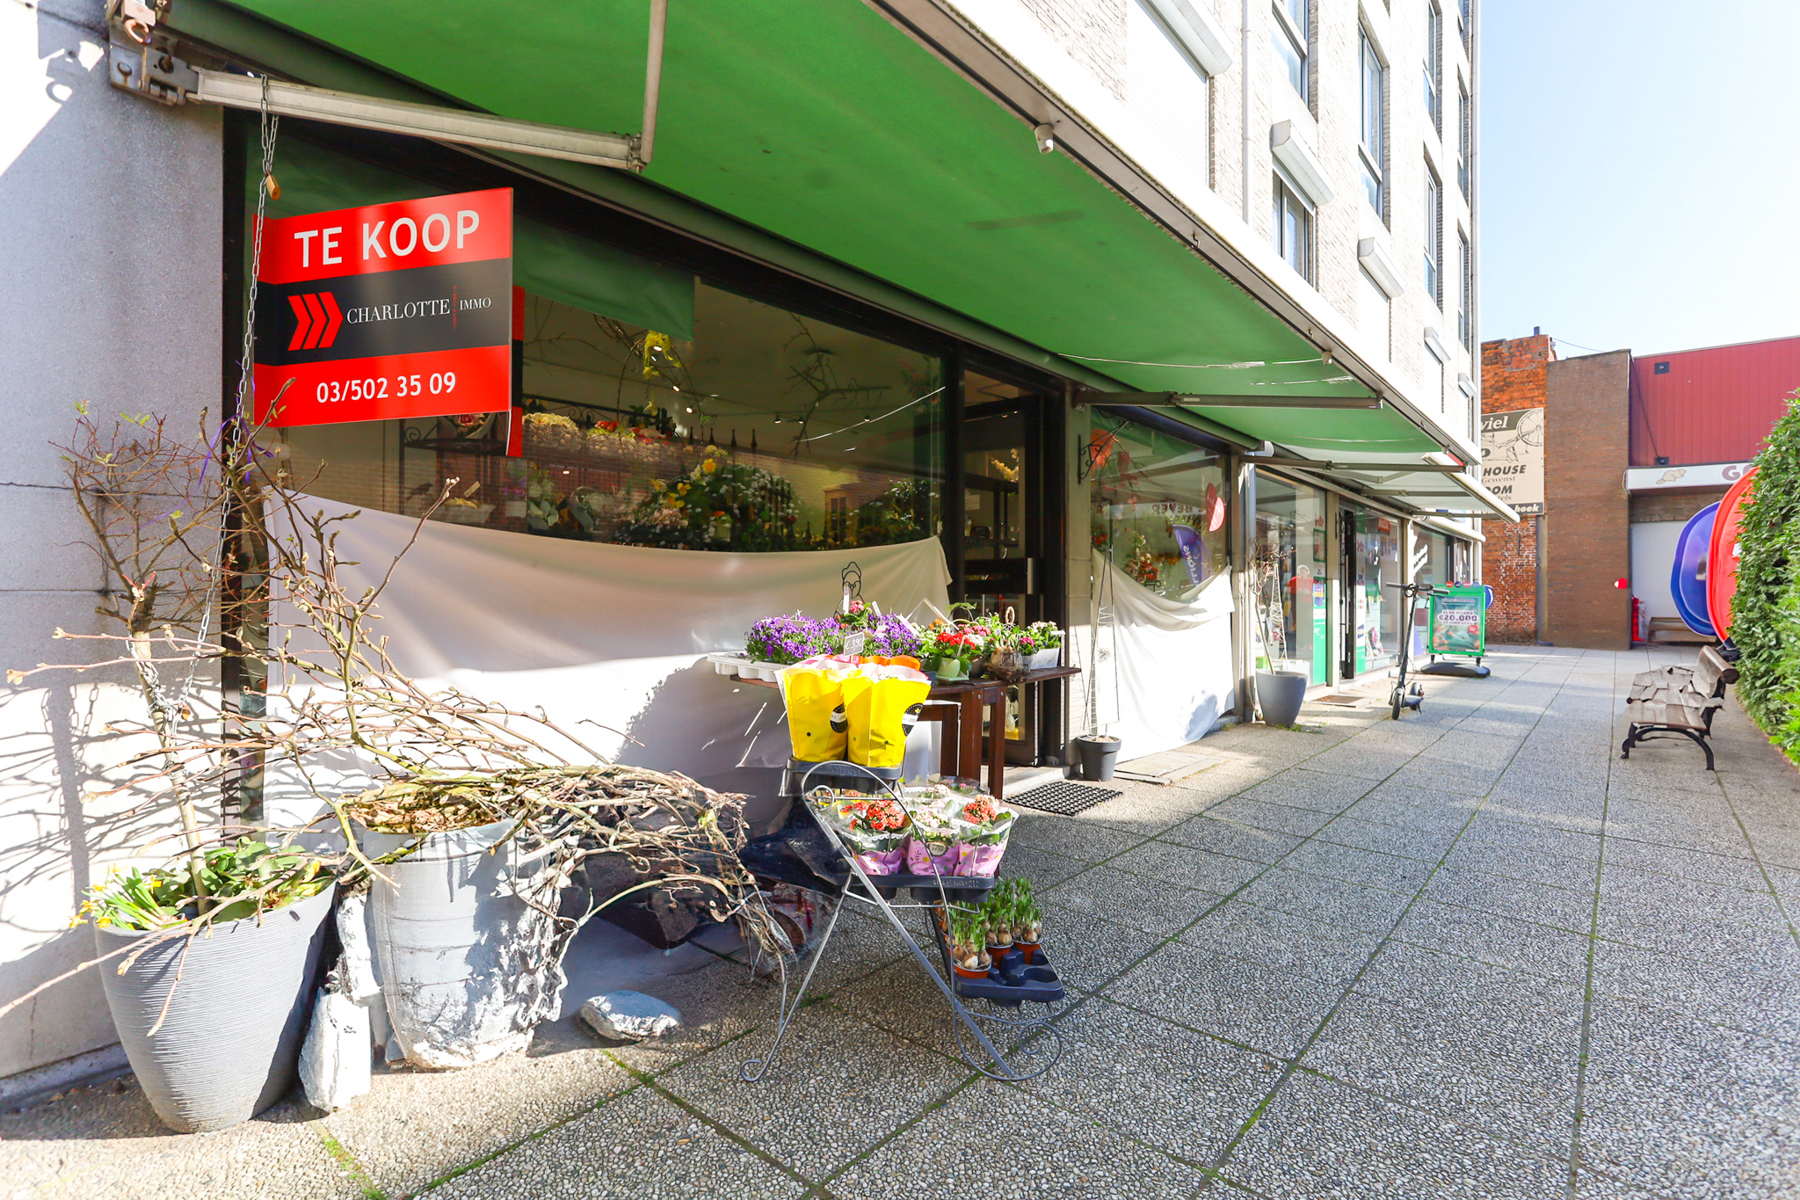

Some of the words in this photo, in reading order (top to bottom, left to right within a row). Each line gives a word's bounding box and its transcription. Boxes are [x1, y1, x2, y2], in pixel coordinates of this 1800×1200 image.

[294, 226, 343, 268] TE
[362, 210, 480, 260] KOOP
[346, 298, 451, 325] CHARLOTTE
[459, 297, 492, 311] IMMO
[316, 377, 389, 403] 03/502
[396, 374, 422, 397] 35
[429, 371, 456, 394] 09
[1483, 465, 1526, 476] HOUSE
